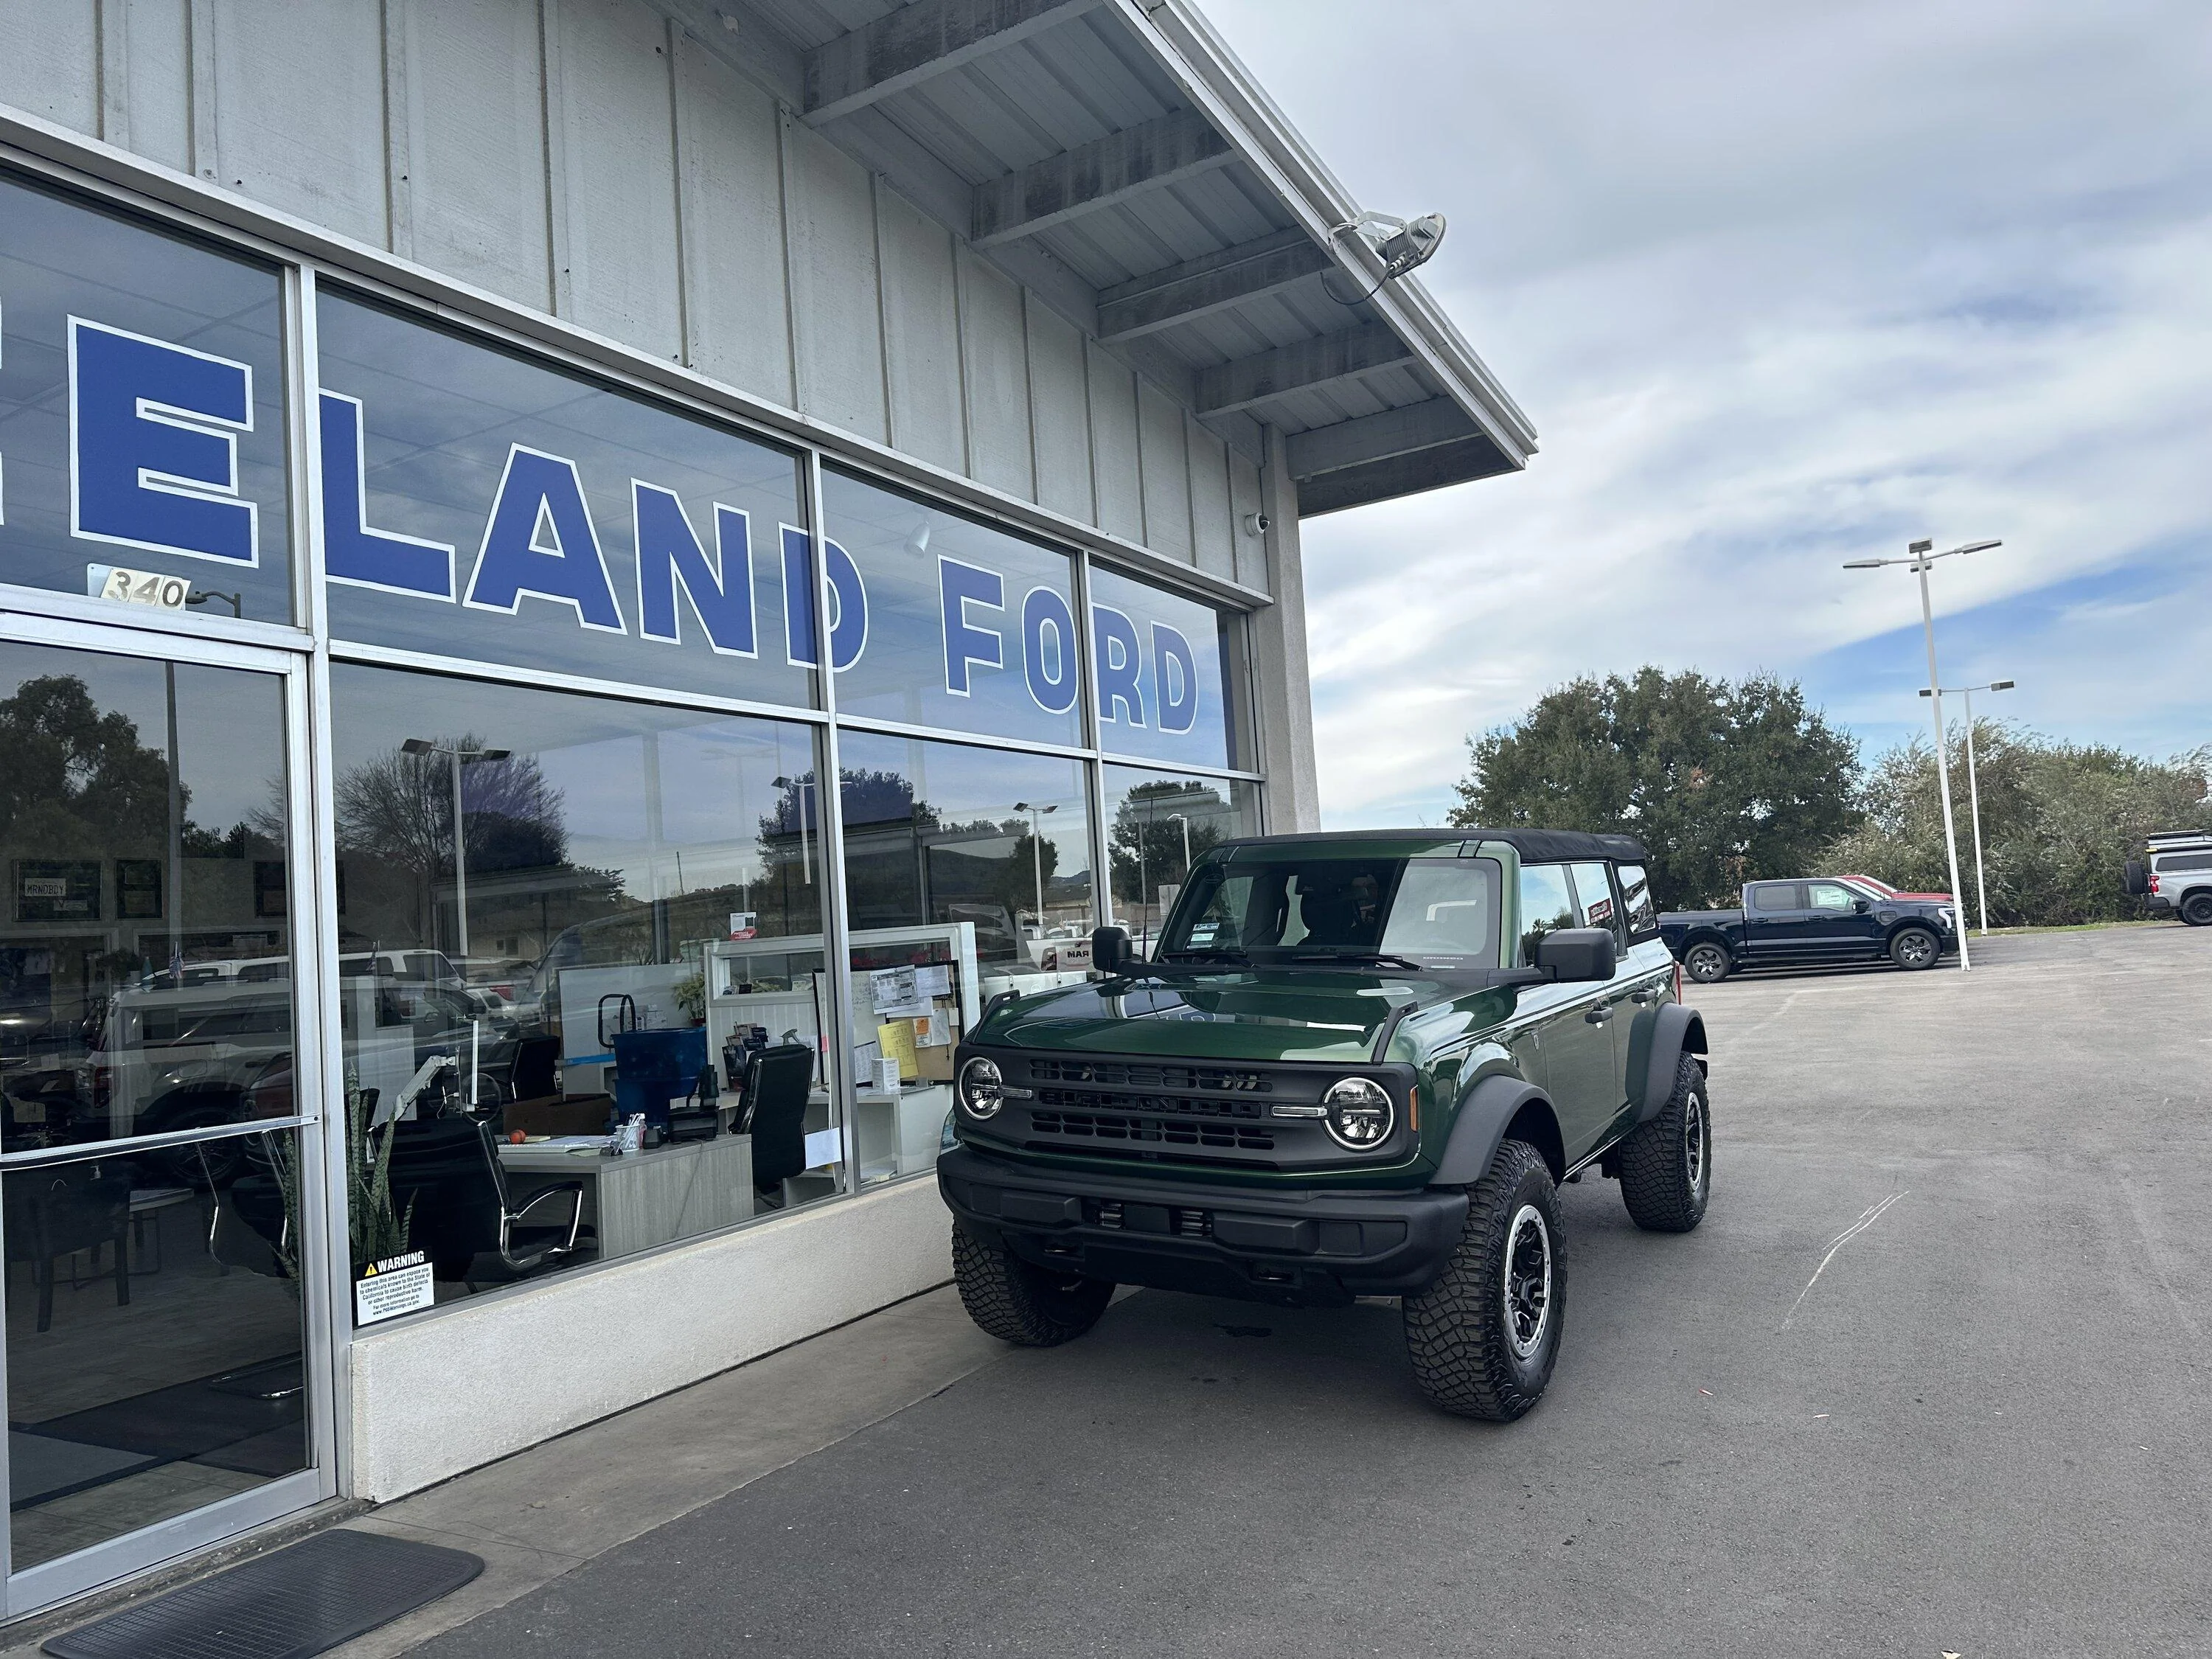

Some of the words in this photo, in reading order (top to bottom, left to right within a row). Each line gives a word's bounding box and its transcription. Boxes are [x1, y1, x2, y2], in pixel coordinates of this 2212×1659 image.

[0, 296, 868, 673] ELAND
[937, 554, 1198, 735] FORD
[108, 571, 184, 608] 340
[1039, 1091, 1262, 1119] BRONCO
[378, 1251, 424, 1273] WARNING
[363, 1292, 383, 1300] California
[366, 1284, 387, 1293] chemicals
[386, 1290, 411, 1300] reproductive
[390, 1297, 410, 1305] information
